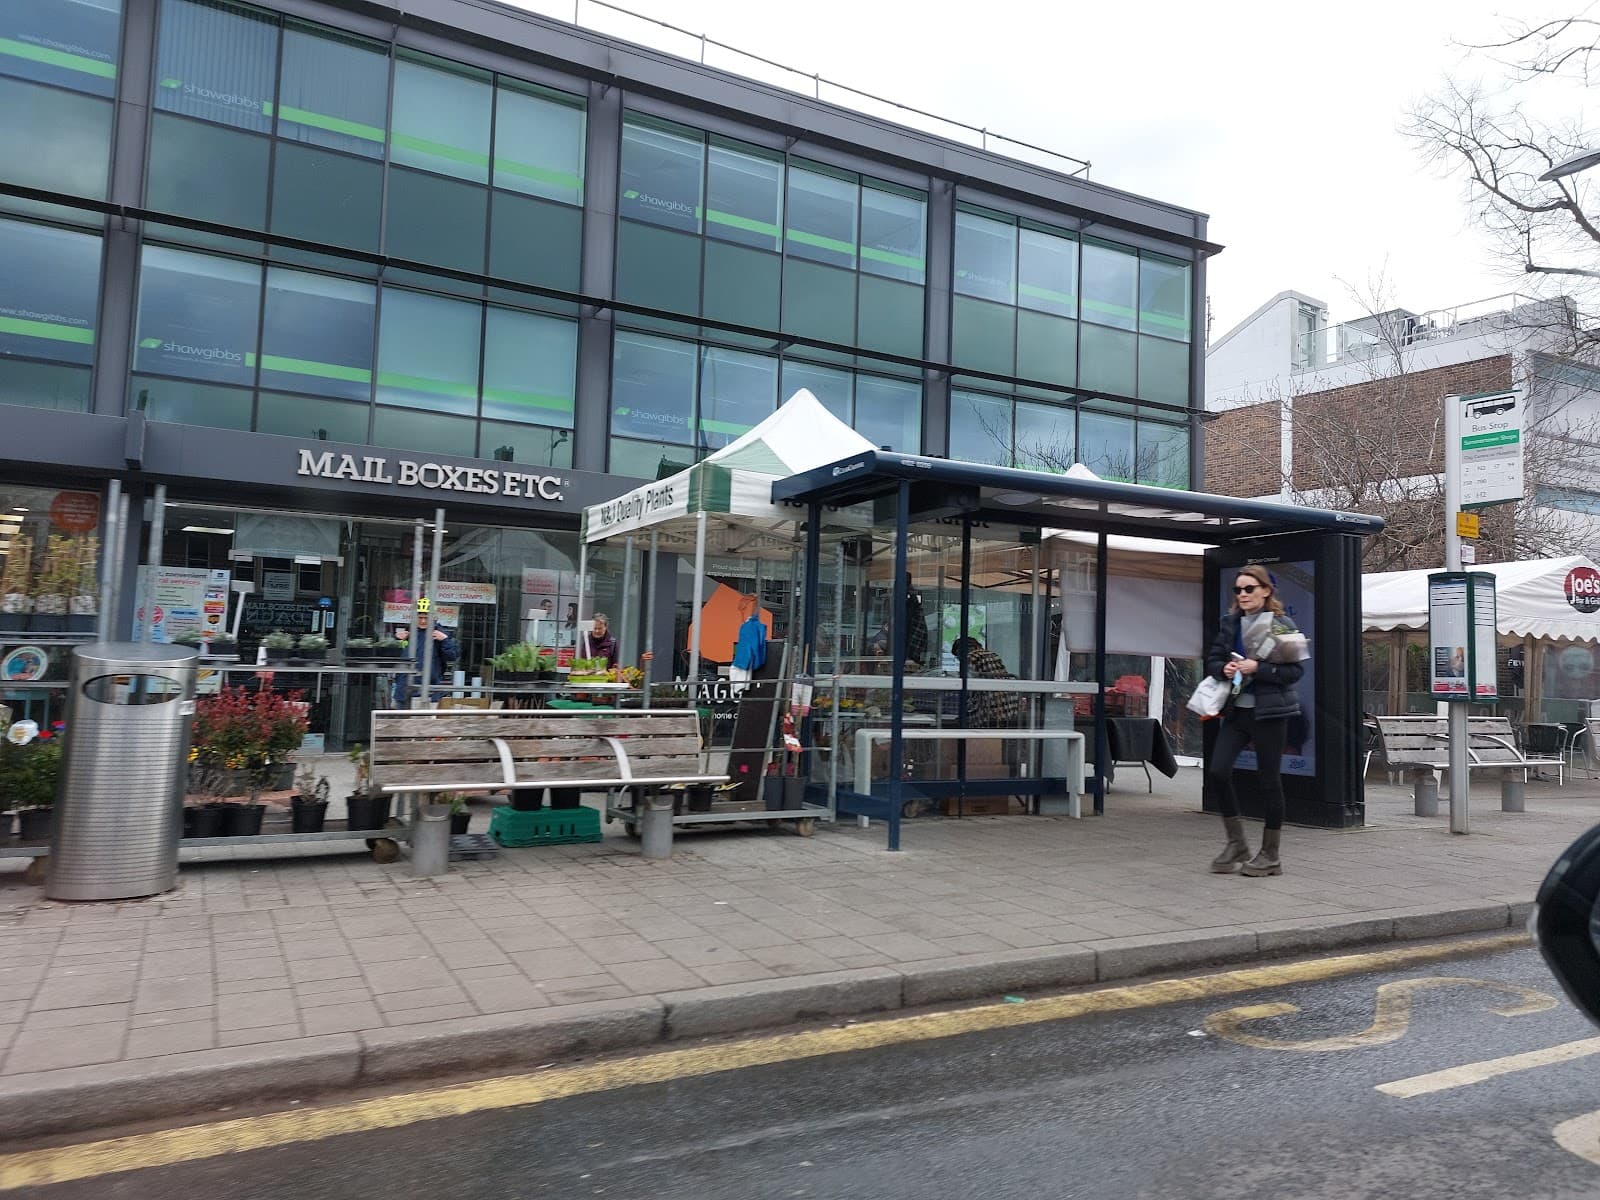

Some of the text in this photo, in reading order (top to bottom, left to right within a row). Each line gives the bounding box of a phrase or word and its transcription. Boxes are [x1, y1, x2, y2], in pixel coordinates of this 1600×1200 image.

[184, 84, 260, 109] shawgibbs
[639, 193, 693, 213] shawgibbs
[163, 341, 241, 361] shawgibbs
[631, 408, 685, 425] shawgibbs
[1472, 421, 1509, 432] Bus Stop
[297, 449, 392, 484] MAIL
[398, 460, 499, 496] BOXES
[616, 494, 645, 523] Quality
[645, 484, 674, 514] Plants
[1569, 573, 1600, 604] Joe's
